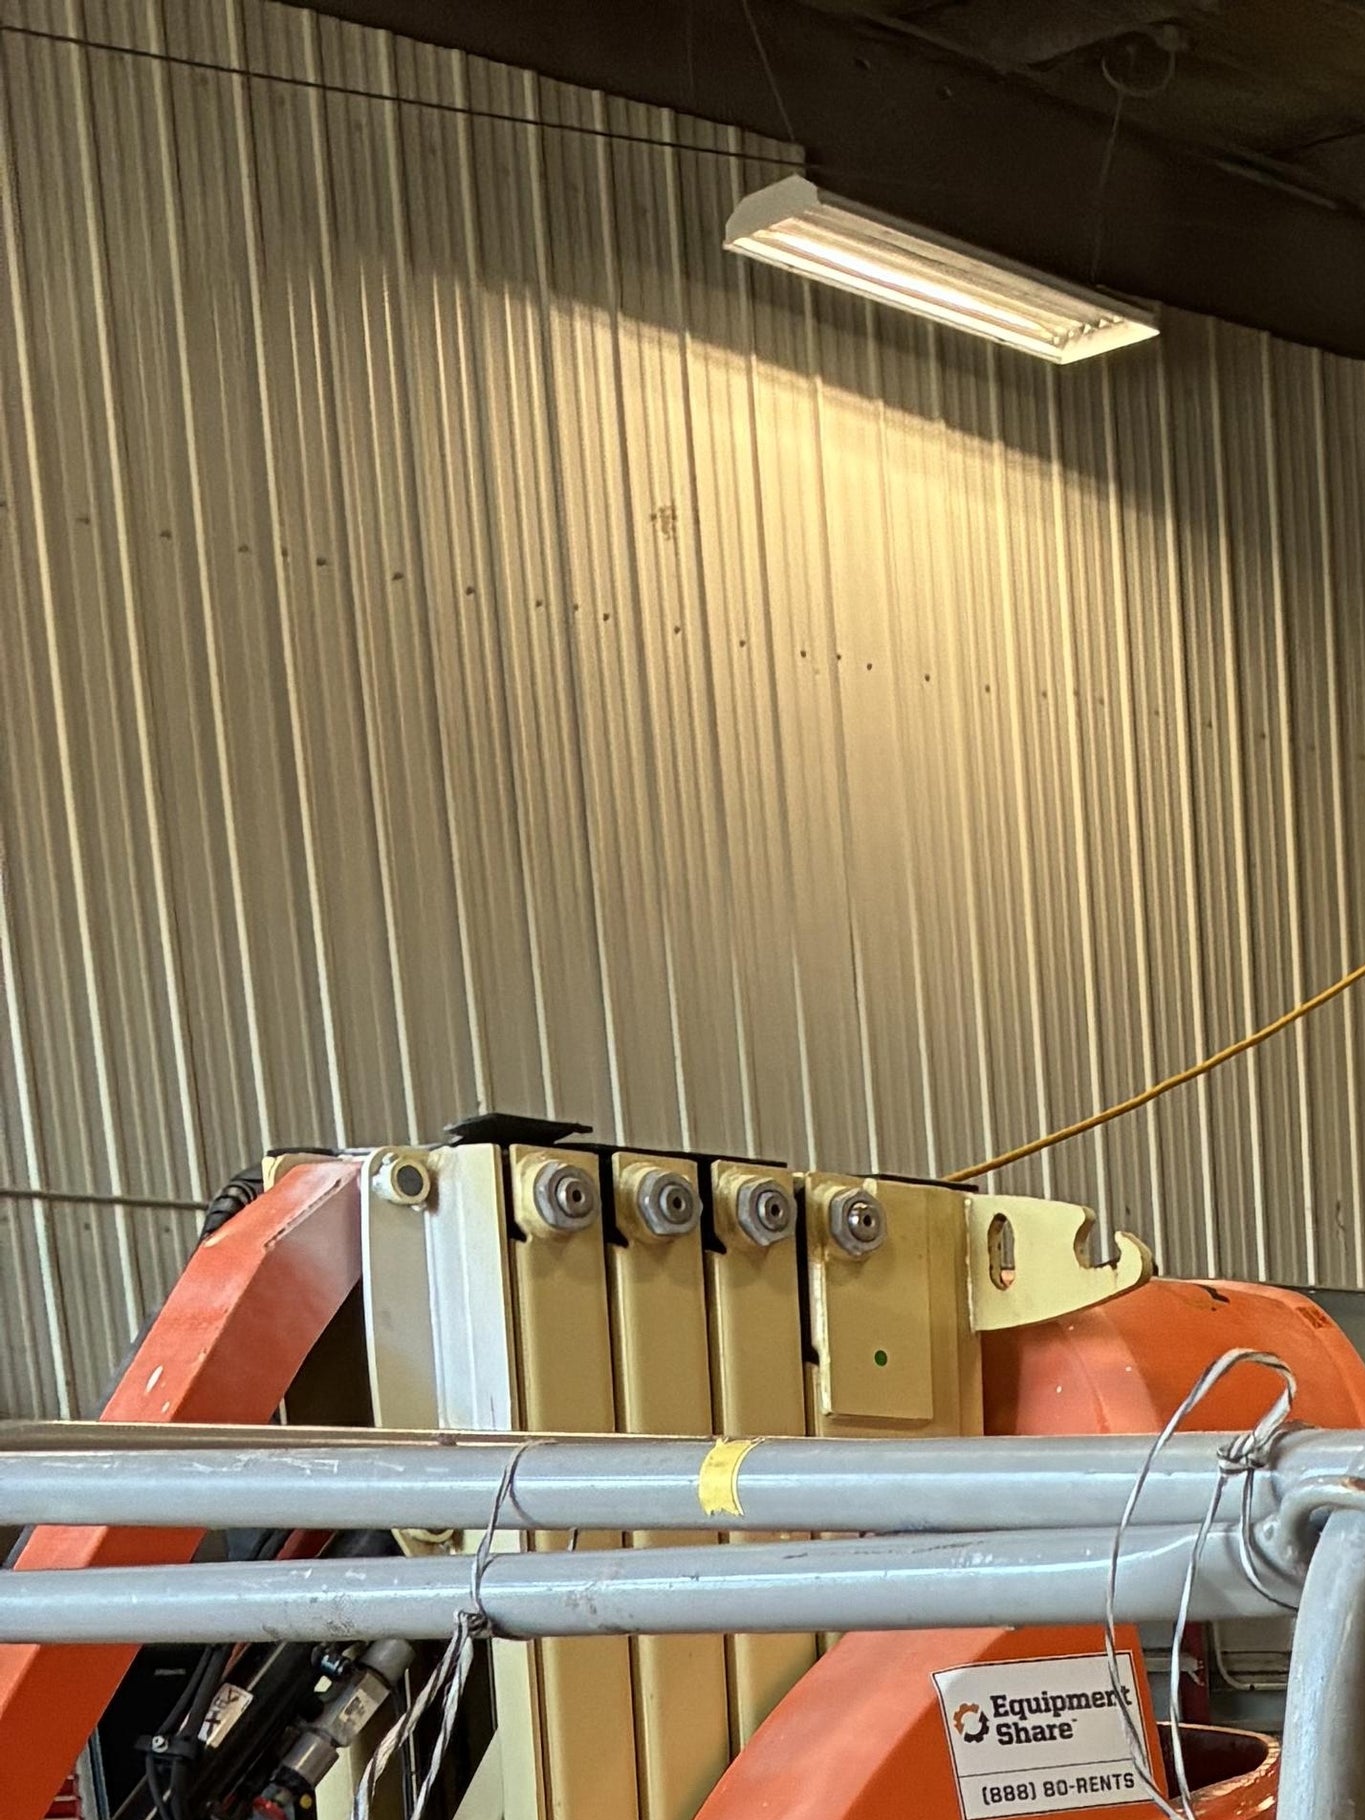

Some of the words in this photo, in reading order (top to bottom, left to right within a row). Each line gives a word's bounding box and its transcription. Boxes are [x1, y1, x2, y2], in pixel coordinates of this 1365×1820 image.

[990, 1685, 1133, 1720] Equipment
[996, 1720, 1074, 1747] Share
[982, 1781, 1038, 1806] (888)
[1043, 1772, 1135, 1798] 80-RENTS
